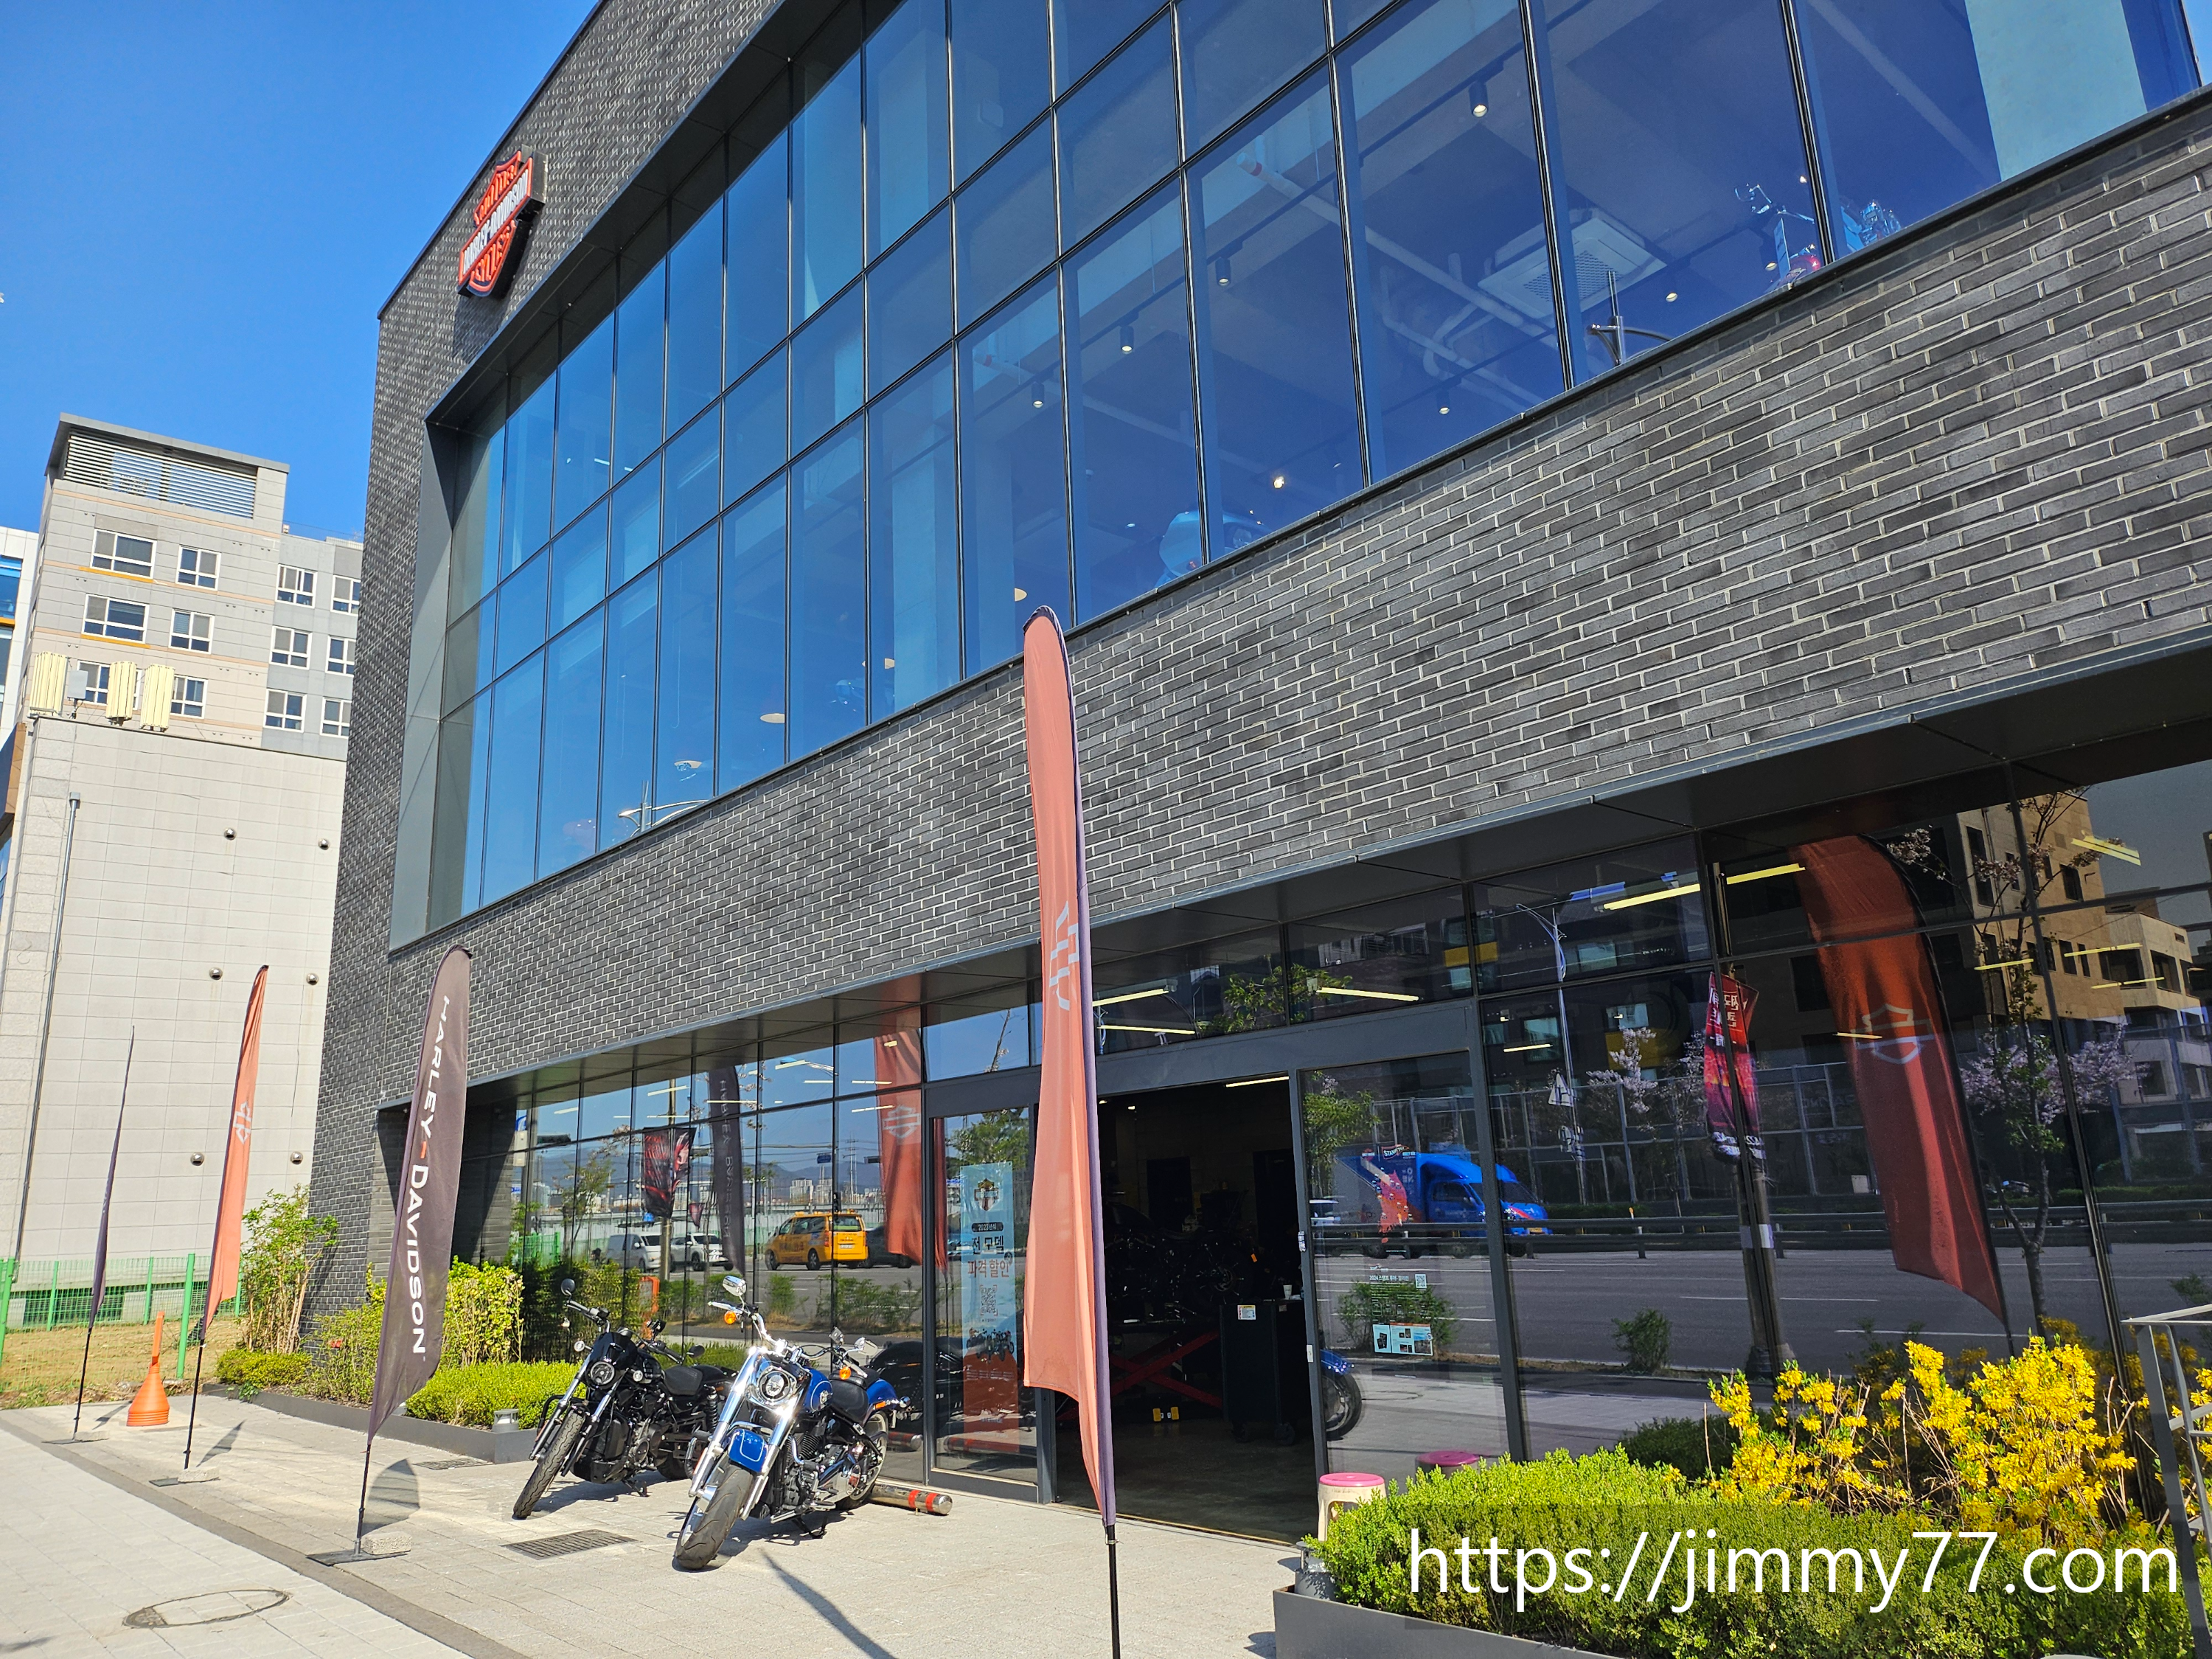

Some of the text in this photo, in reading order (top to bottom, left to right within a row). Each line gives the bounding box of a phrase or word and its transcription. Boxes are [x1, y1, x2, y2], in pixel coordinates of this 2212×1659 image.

[971, 1235, 1004, 1255] 전 모델
[967, 1259, 1009, 1279] 파격 할인
